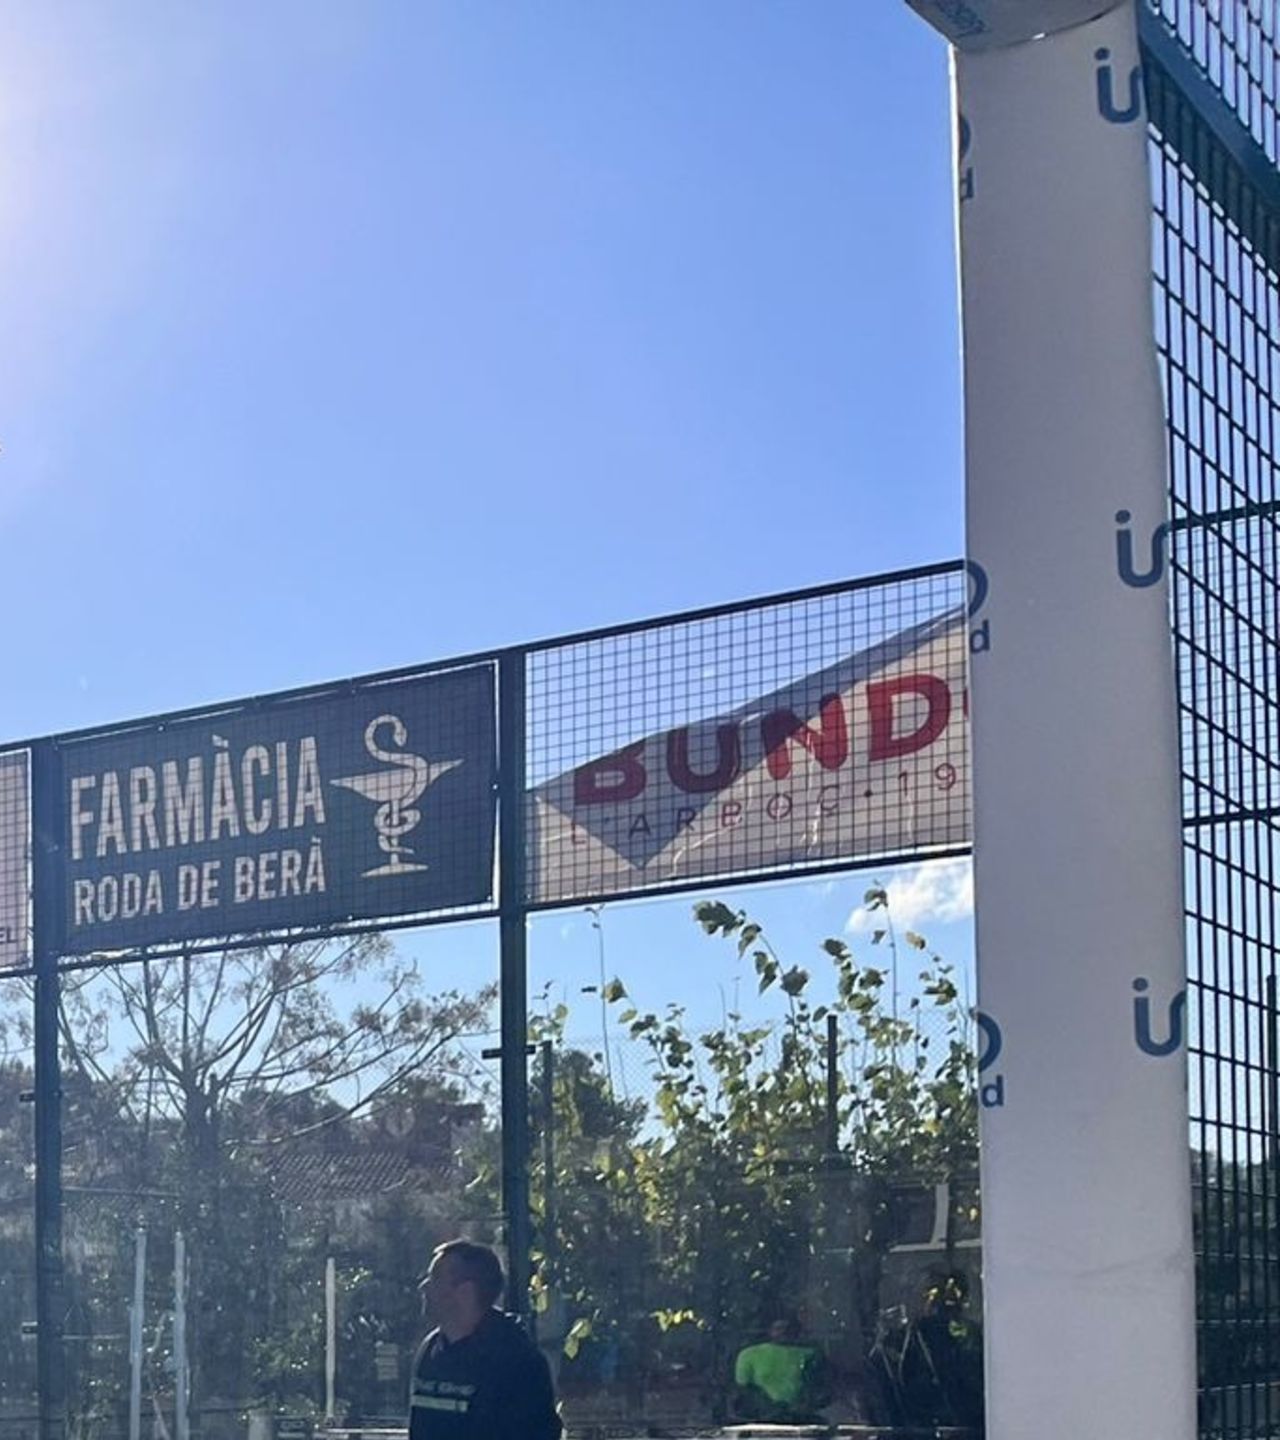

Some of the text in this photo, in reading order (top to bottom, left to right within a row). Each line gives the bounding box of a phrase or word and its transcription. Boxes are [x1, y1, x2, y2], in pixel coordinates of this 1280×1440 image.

[71, 733, 326, 861] FARMÀCIA
[574, 673, 968, 805] BUND
[74, 836, 326, 926] RODA DE BERÀ
